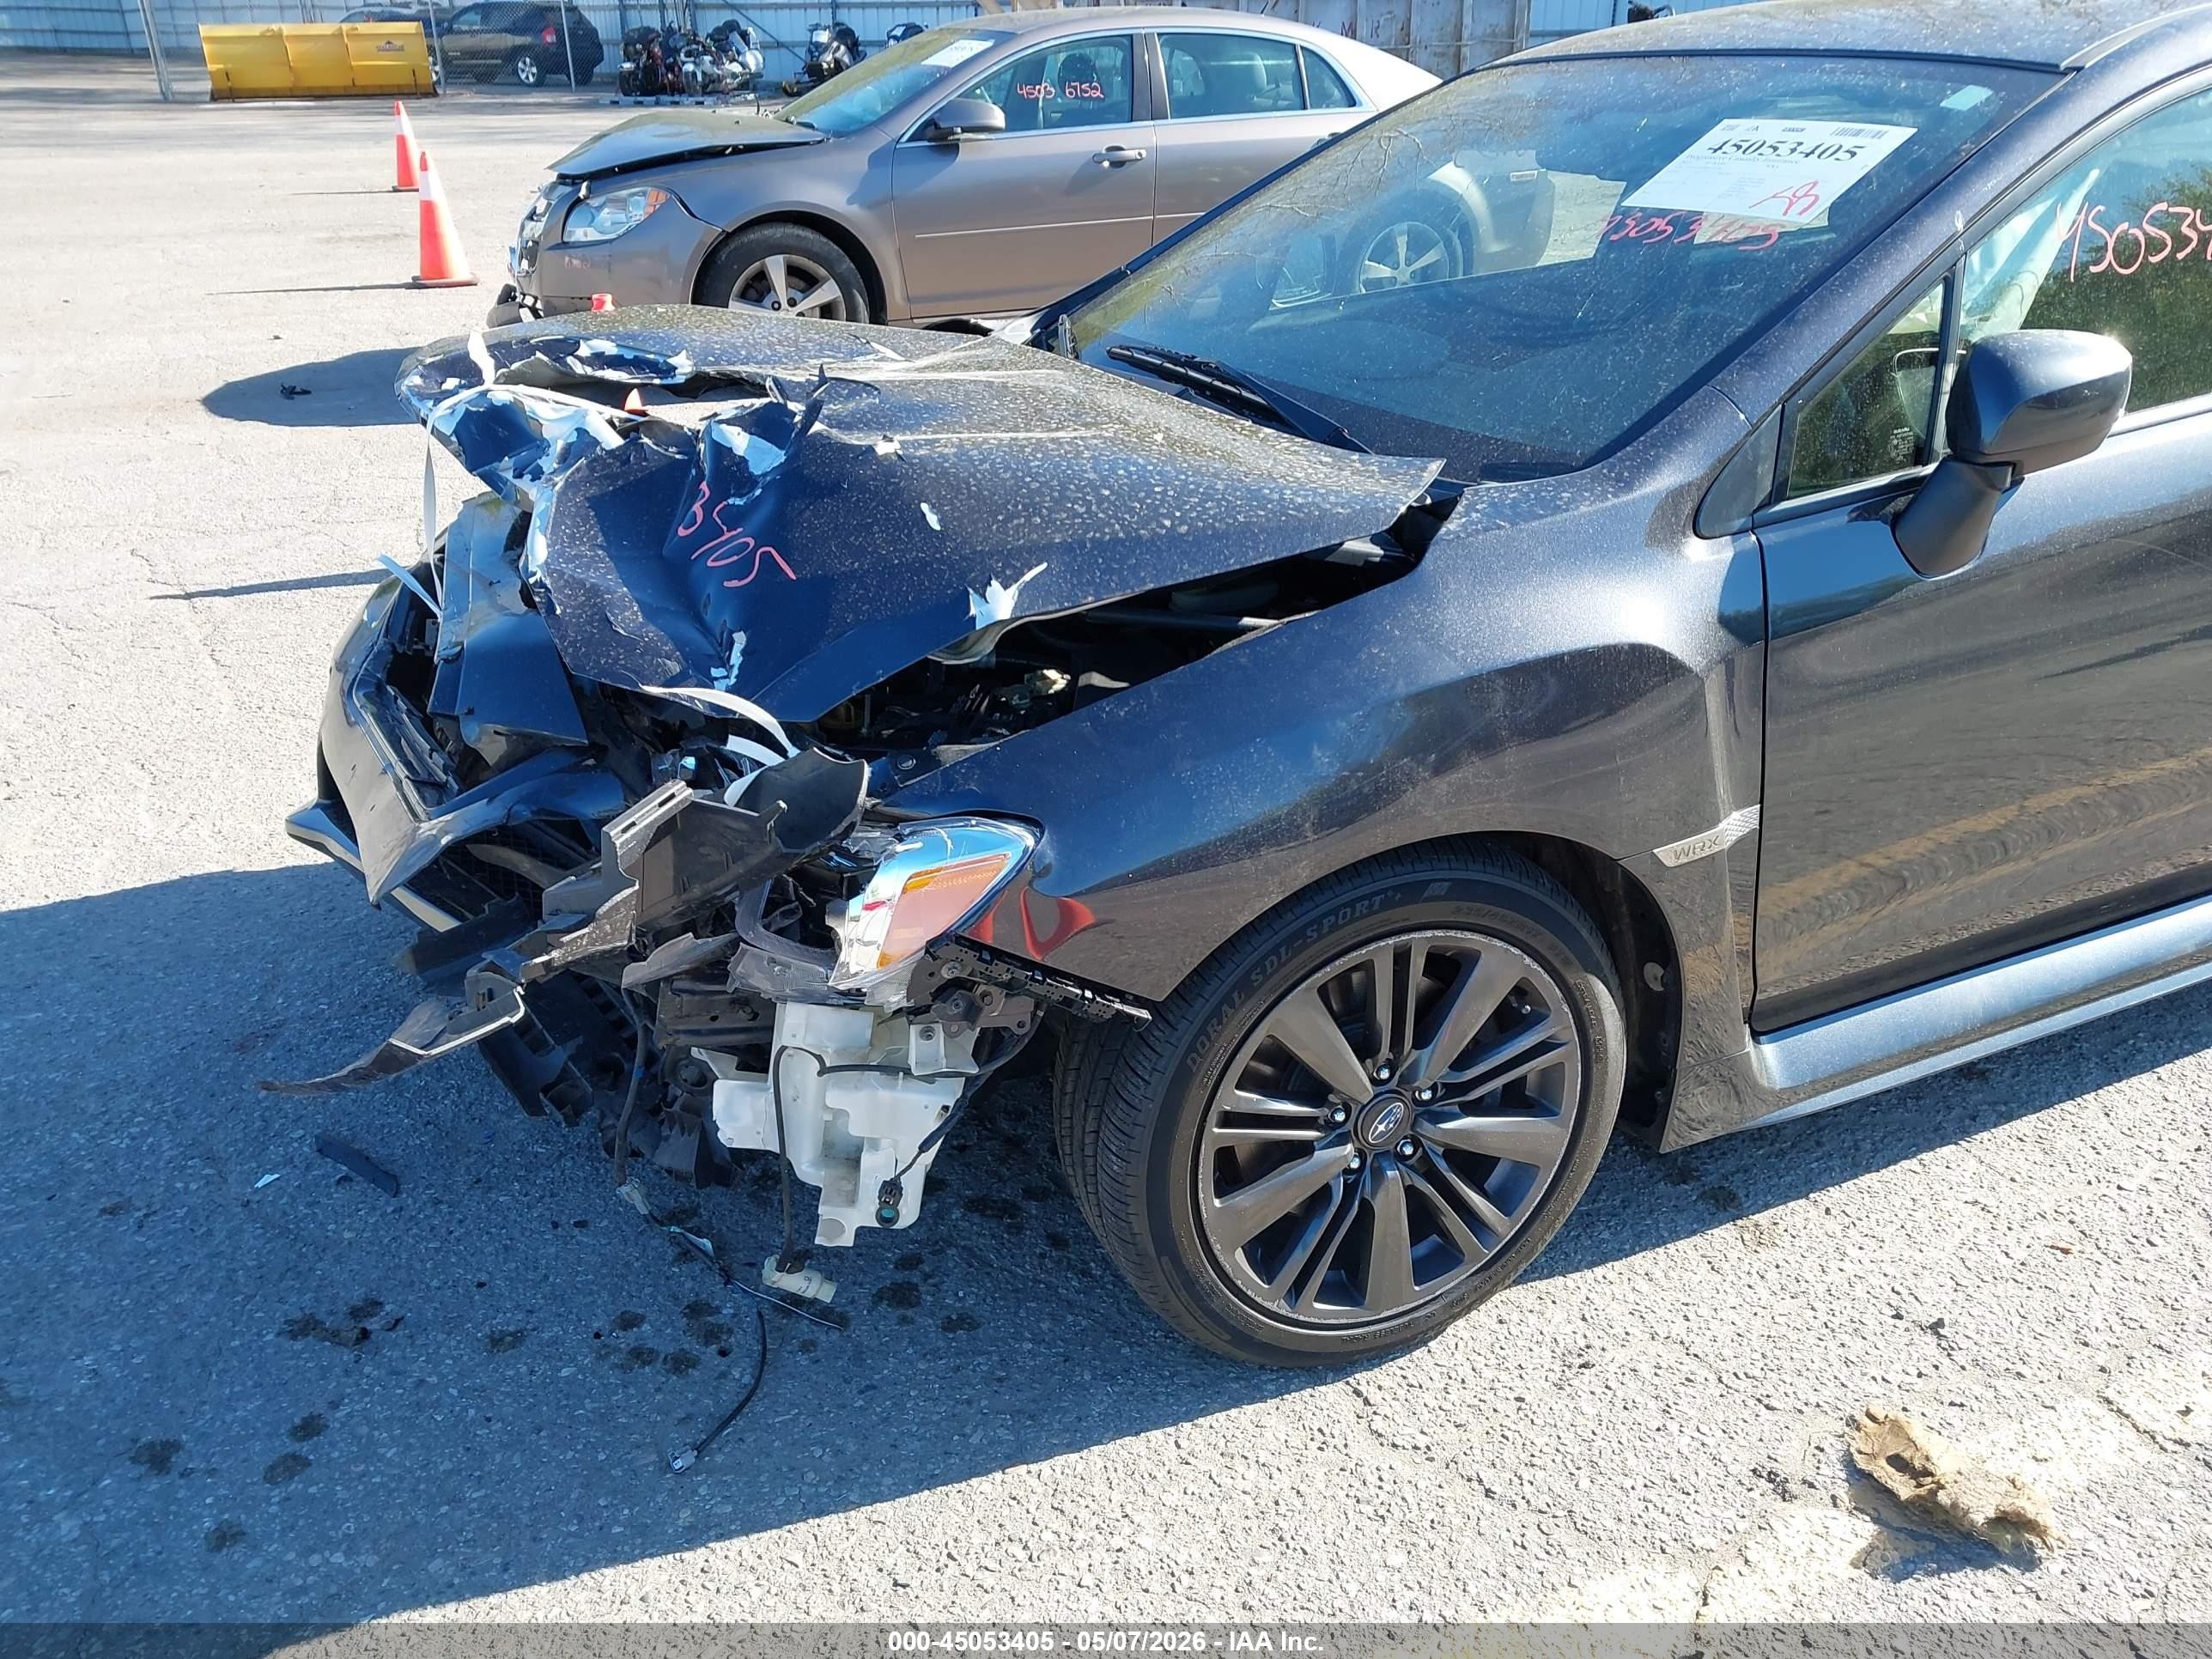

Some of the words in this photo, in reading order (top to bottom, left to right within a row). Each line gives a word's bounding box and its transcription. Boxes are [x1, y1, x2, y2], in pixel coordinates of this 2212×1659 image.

[1017, 82, 1055, 99] 4503
[1066, 81, 1104, 99] 6752
[1707, 137, 1865, 162] 45053405
[1674, 836, 1719, 861] WRX
[1187, 988, 1245, 1073] DORAL
